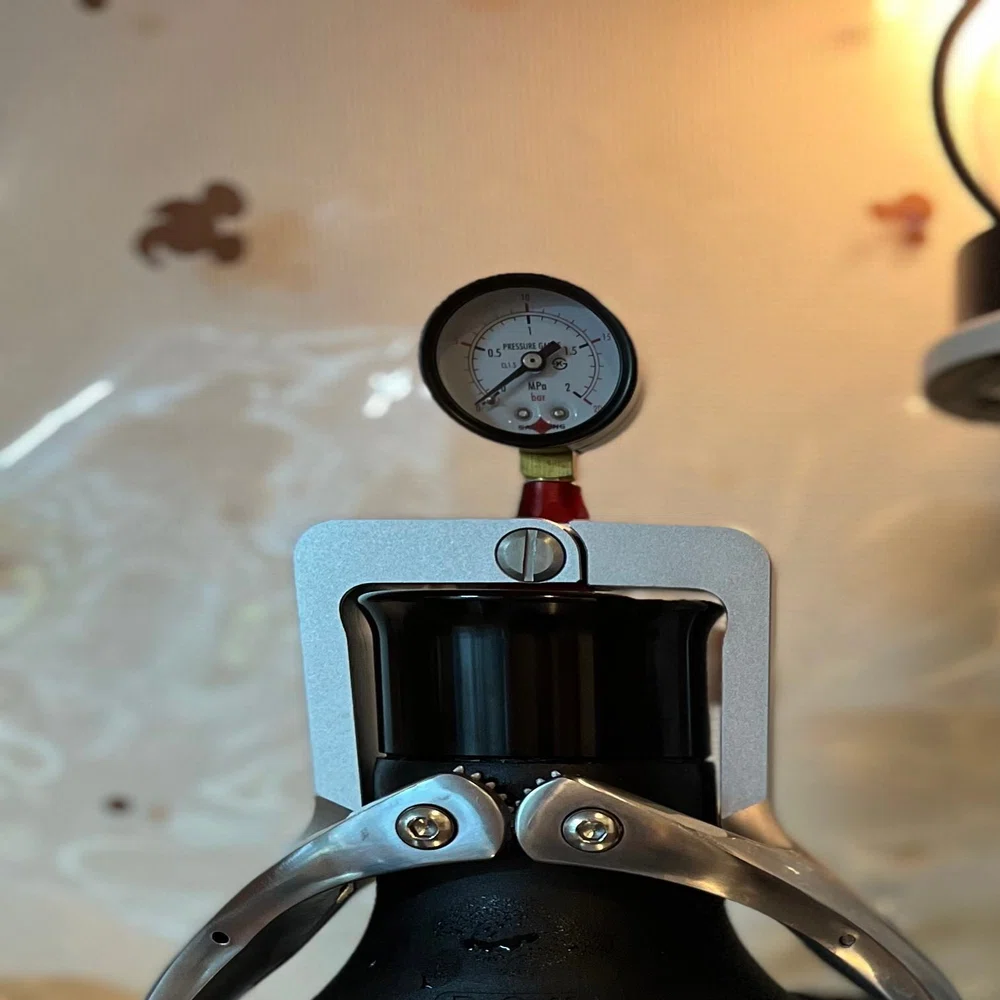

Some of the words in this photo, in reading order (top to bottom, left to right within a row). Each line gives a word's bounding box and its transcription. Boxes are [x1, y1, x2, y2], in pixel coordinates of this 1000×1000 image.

[528, 327, 532, 335] 1
[502, 342, 537, 350] PRESSURE
[563, 345, 578, 356] 1.5
[487, 349, 502, 358] 0.5
[528, 381, 547, 391] MPa
[565, 383, 571, 392] 2
[531, 393, 546, 402] bar
